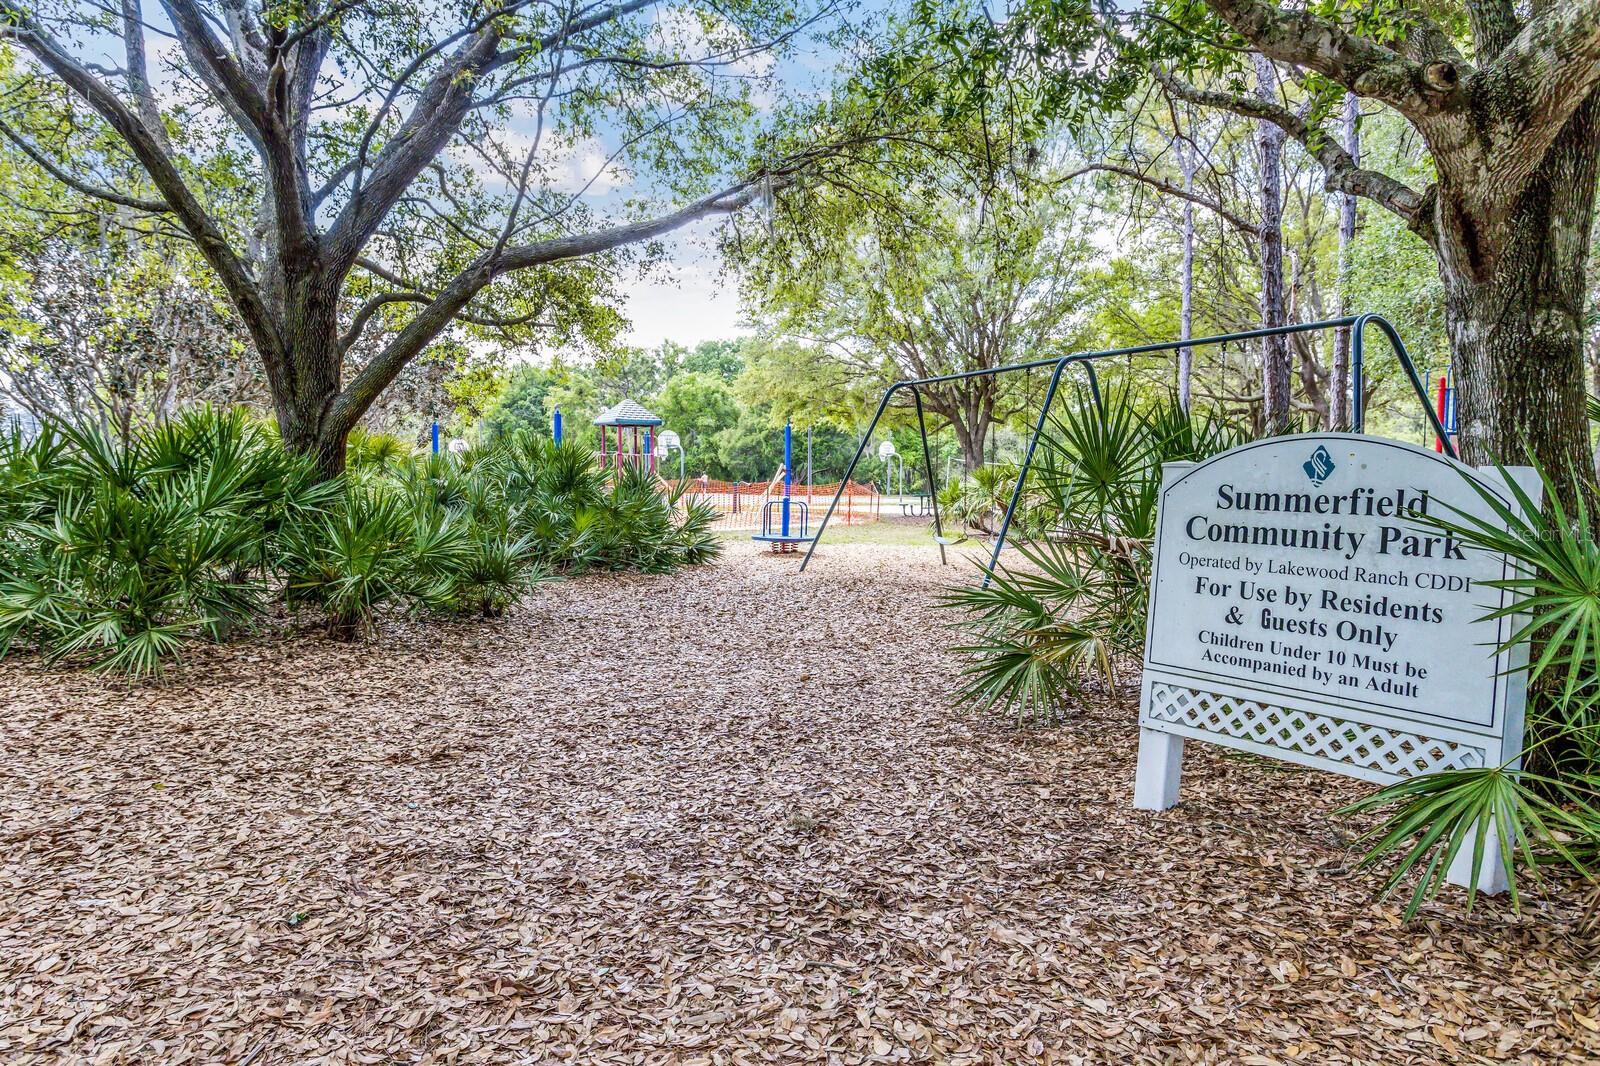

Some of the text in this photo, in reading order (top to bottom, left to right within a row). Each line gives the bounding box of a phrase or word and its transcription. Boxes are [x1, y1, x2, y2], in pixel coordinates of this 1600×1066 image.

[1216, 484, 1429, 519] Summerfield
[1185, 515, 1468, 561] Community Park
[1179, 551, 1240, 571] Operated
[1245, 557, 1263, 576] by
[1268, 559, 1349, 582] Lakewood
[1354, 566, 1409, 588] Ranch
[1194, 576, 1443, 624] For Use by Residents
[1224, 605, 1399, 653] & Guests Only
[1198, 629, 1428, 680] Children Under 10 Must be
[1201, 648, 1420, 699] Accompanied by an Adult
